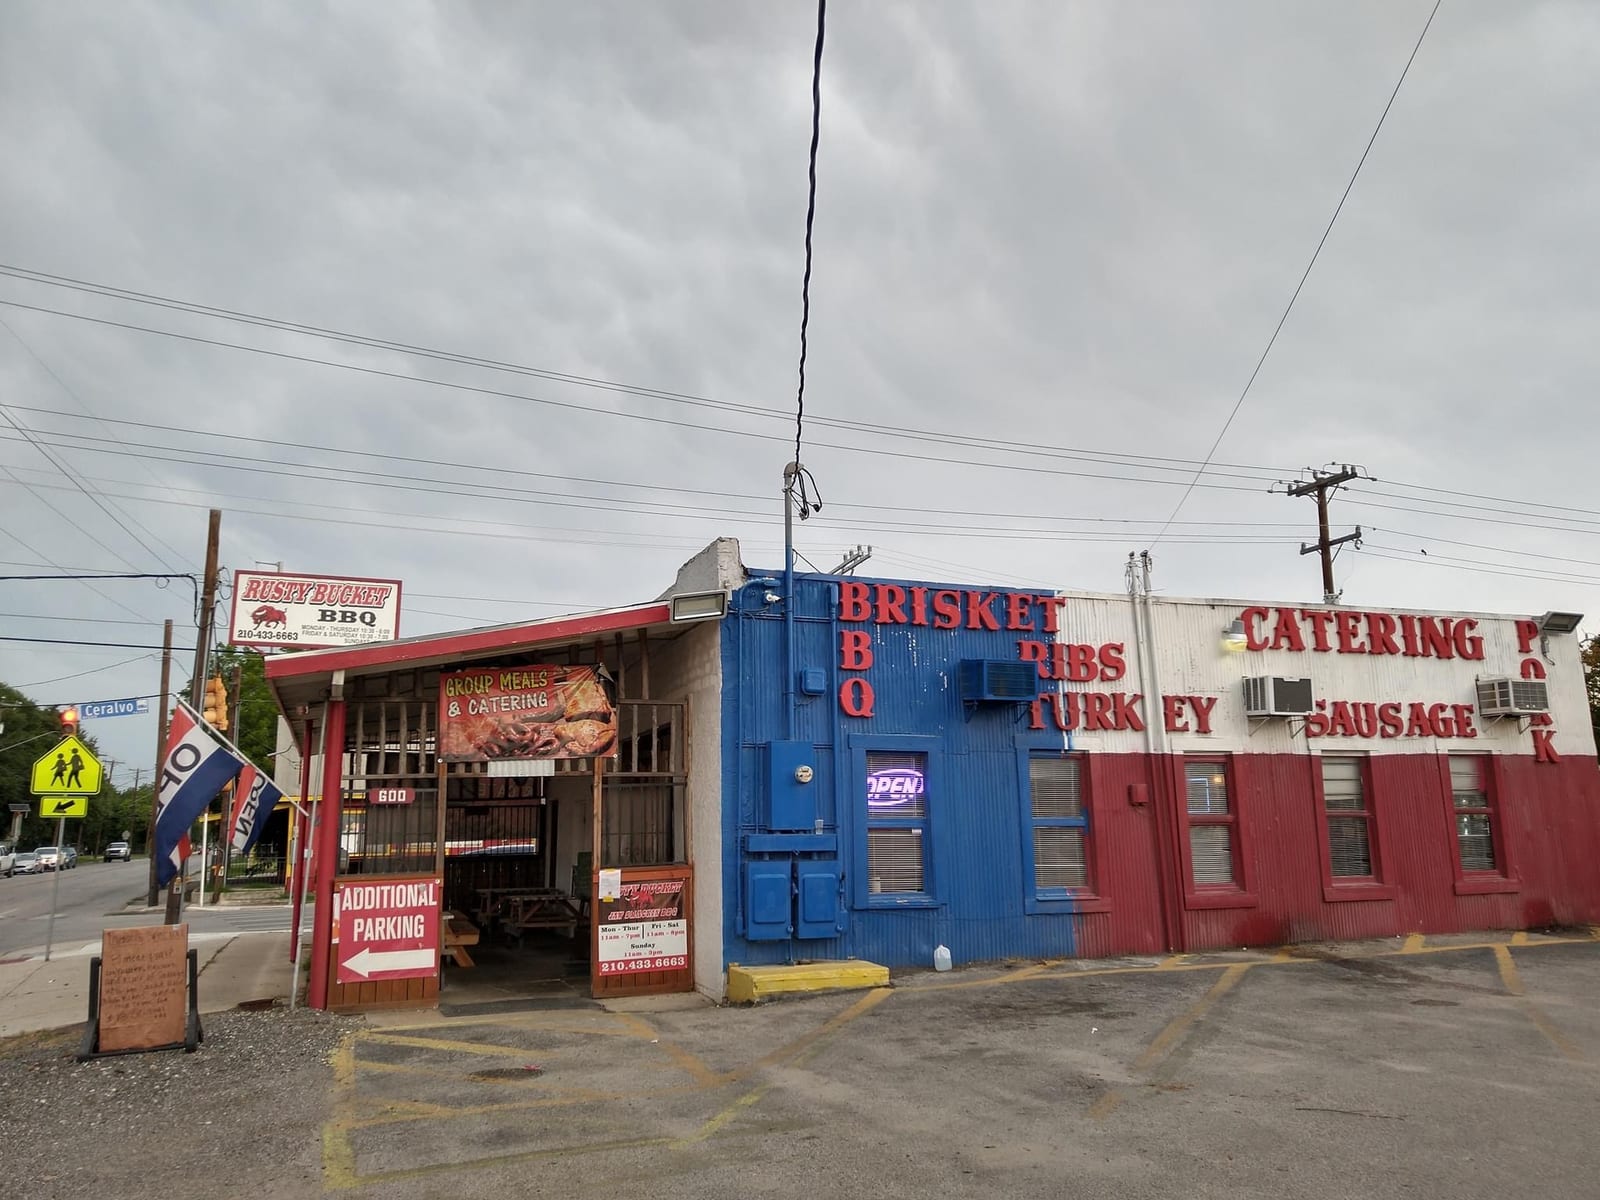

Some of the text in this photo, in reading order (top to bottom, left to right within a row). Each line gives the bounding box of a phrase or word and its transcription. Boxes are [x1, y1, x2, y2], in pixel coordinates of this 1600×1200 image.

[242, 578, 391, 607] RUSTY BUCKET
[317, 609, 377, 627] BBQ
[838, 581, 1066, 633] BRISKET
[237, 629, 298, 641] 210-433-6663
[1241, 607, 1485, 661] CATERING
[1016, 640, 1126, 682] RIBS
[446, 669, 548, 697] GROUP MEALS
[85, 702, 134, 716] Ceralvo
[447, 692, 548, 717] & CATERING
[1306, 699, 1477, 739] SAUSAGE
[342, 884, 437, 911] ADDITIONAL
[353, 914, 424, 942] PARKING
[630, 942, 656, 950] Sunday
[601, 956, 685, 972] 210.433.6663
